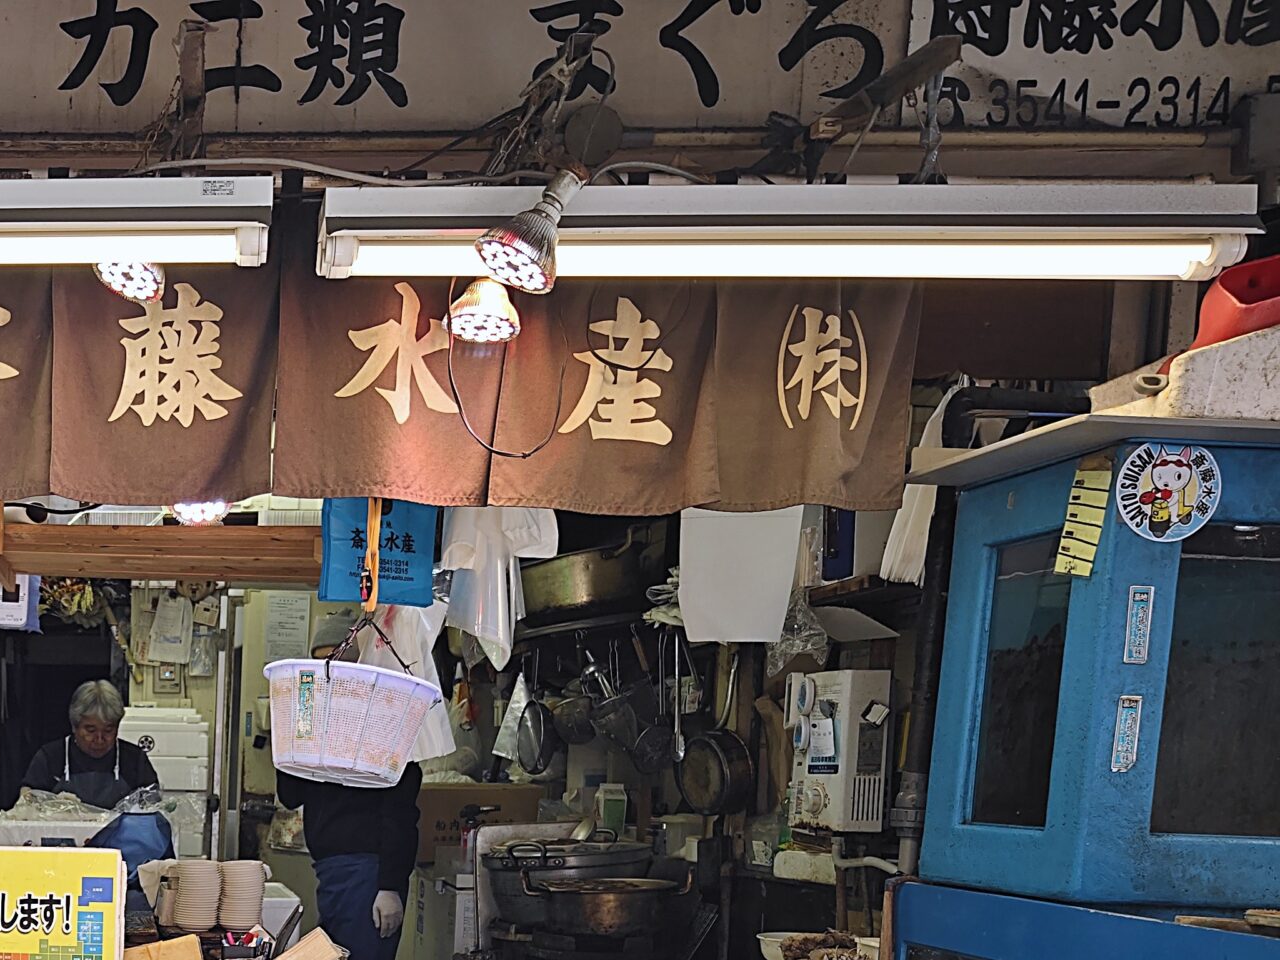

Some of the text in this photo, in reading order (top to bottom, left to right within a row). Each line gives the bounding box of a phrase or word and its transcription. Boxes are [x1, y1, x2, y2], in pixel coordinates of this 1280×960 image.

[986, 76, 1232, 129] 3541-2314
[1120, 446, 1156, 529] SAITO SUISAN
[349, 527, 417, 554] 斎水産
